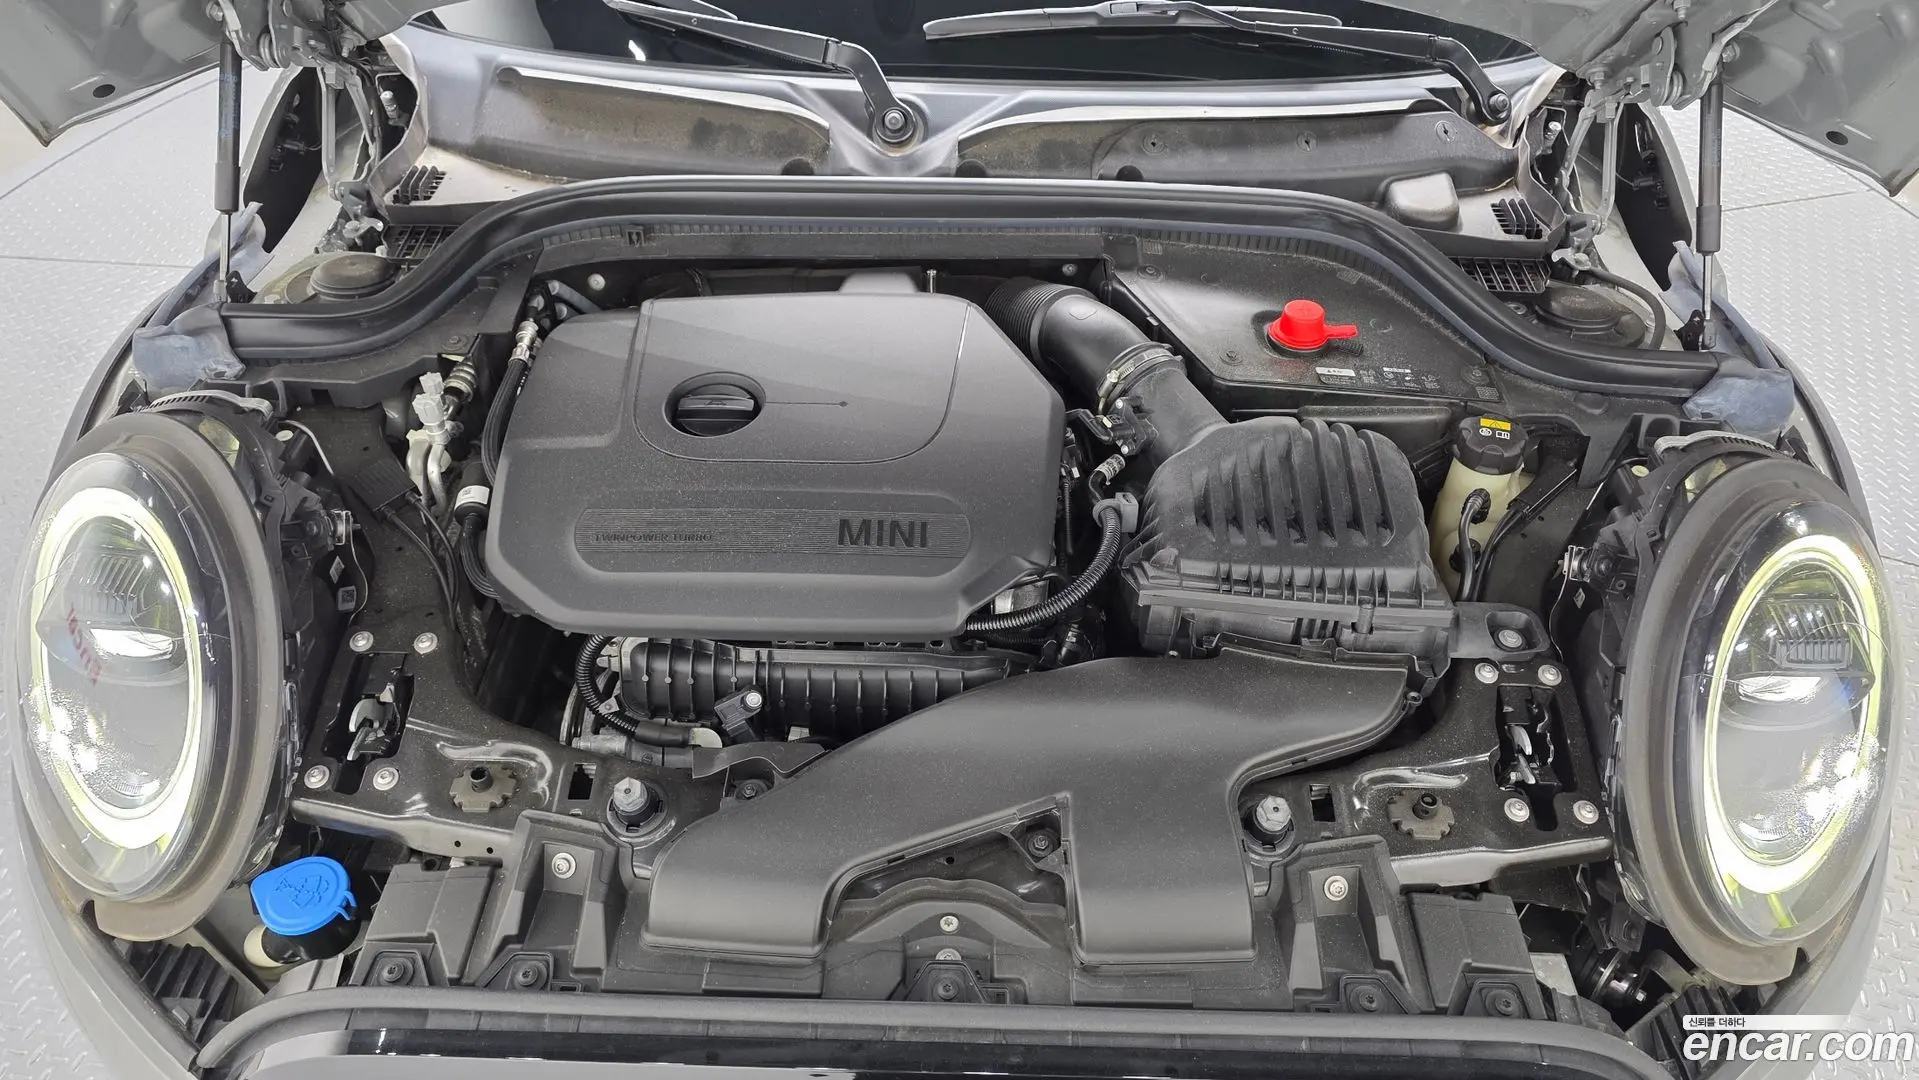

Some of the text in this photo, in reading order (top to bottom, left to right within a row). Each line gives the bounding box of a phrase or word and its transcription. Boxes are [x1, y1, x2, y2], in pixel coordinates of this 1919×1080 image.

[594, 532, 713, 543] TWINPOWER TURBO
[837, 518, 928, 548] MINI
